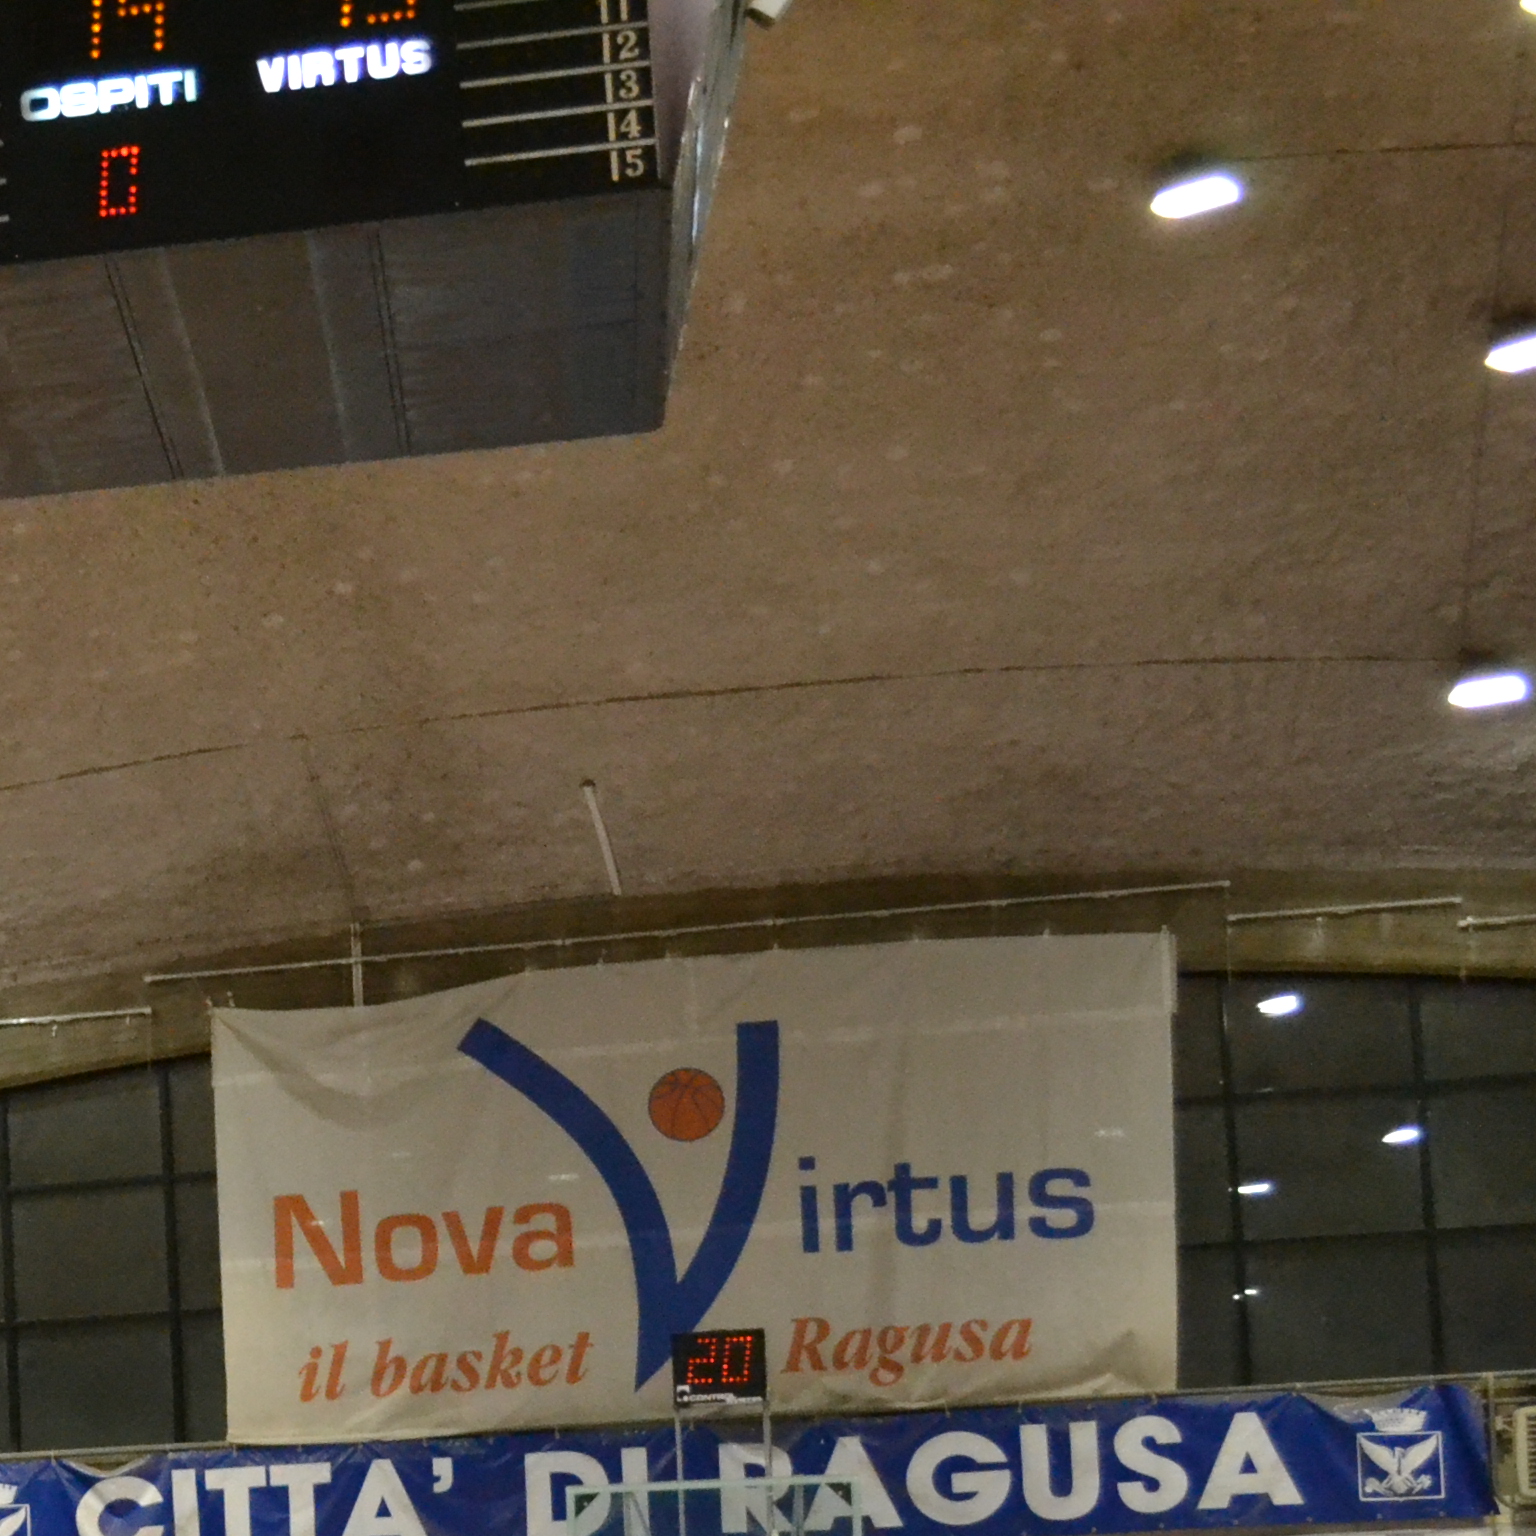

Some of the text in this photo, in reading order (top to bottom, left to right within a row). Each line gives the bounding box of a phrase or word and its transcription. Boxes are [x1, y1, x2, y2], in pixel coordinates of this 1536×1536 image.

[256, 39, 432, 94] VIRTUS
[602, 30, 640, 64] 12
[20, 68, 198, 122] OSPITI
[604, 69, 640, 104] 13
[607, 108, 641, 143] 14
[99, 145, 140, 218] 0
[609, 148, 645, 182] 15
[272, 1188, 576, 1290] Nova
[298, 1315, 1034, 1405] il basket Ragusa
[686, 1335, 754, 1385] 20
[718, 1410, 1306, 1536] RAGUSA
